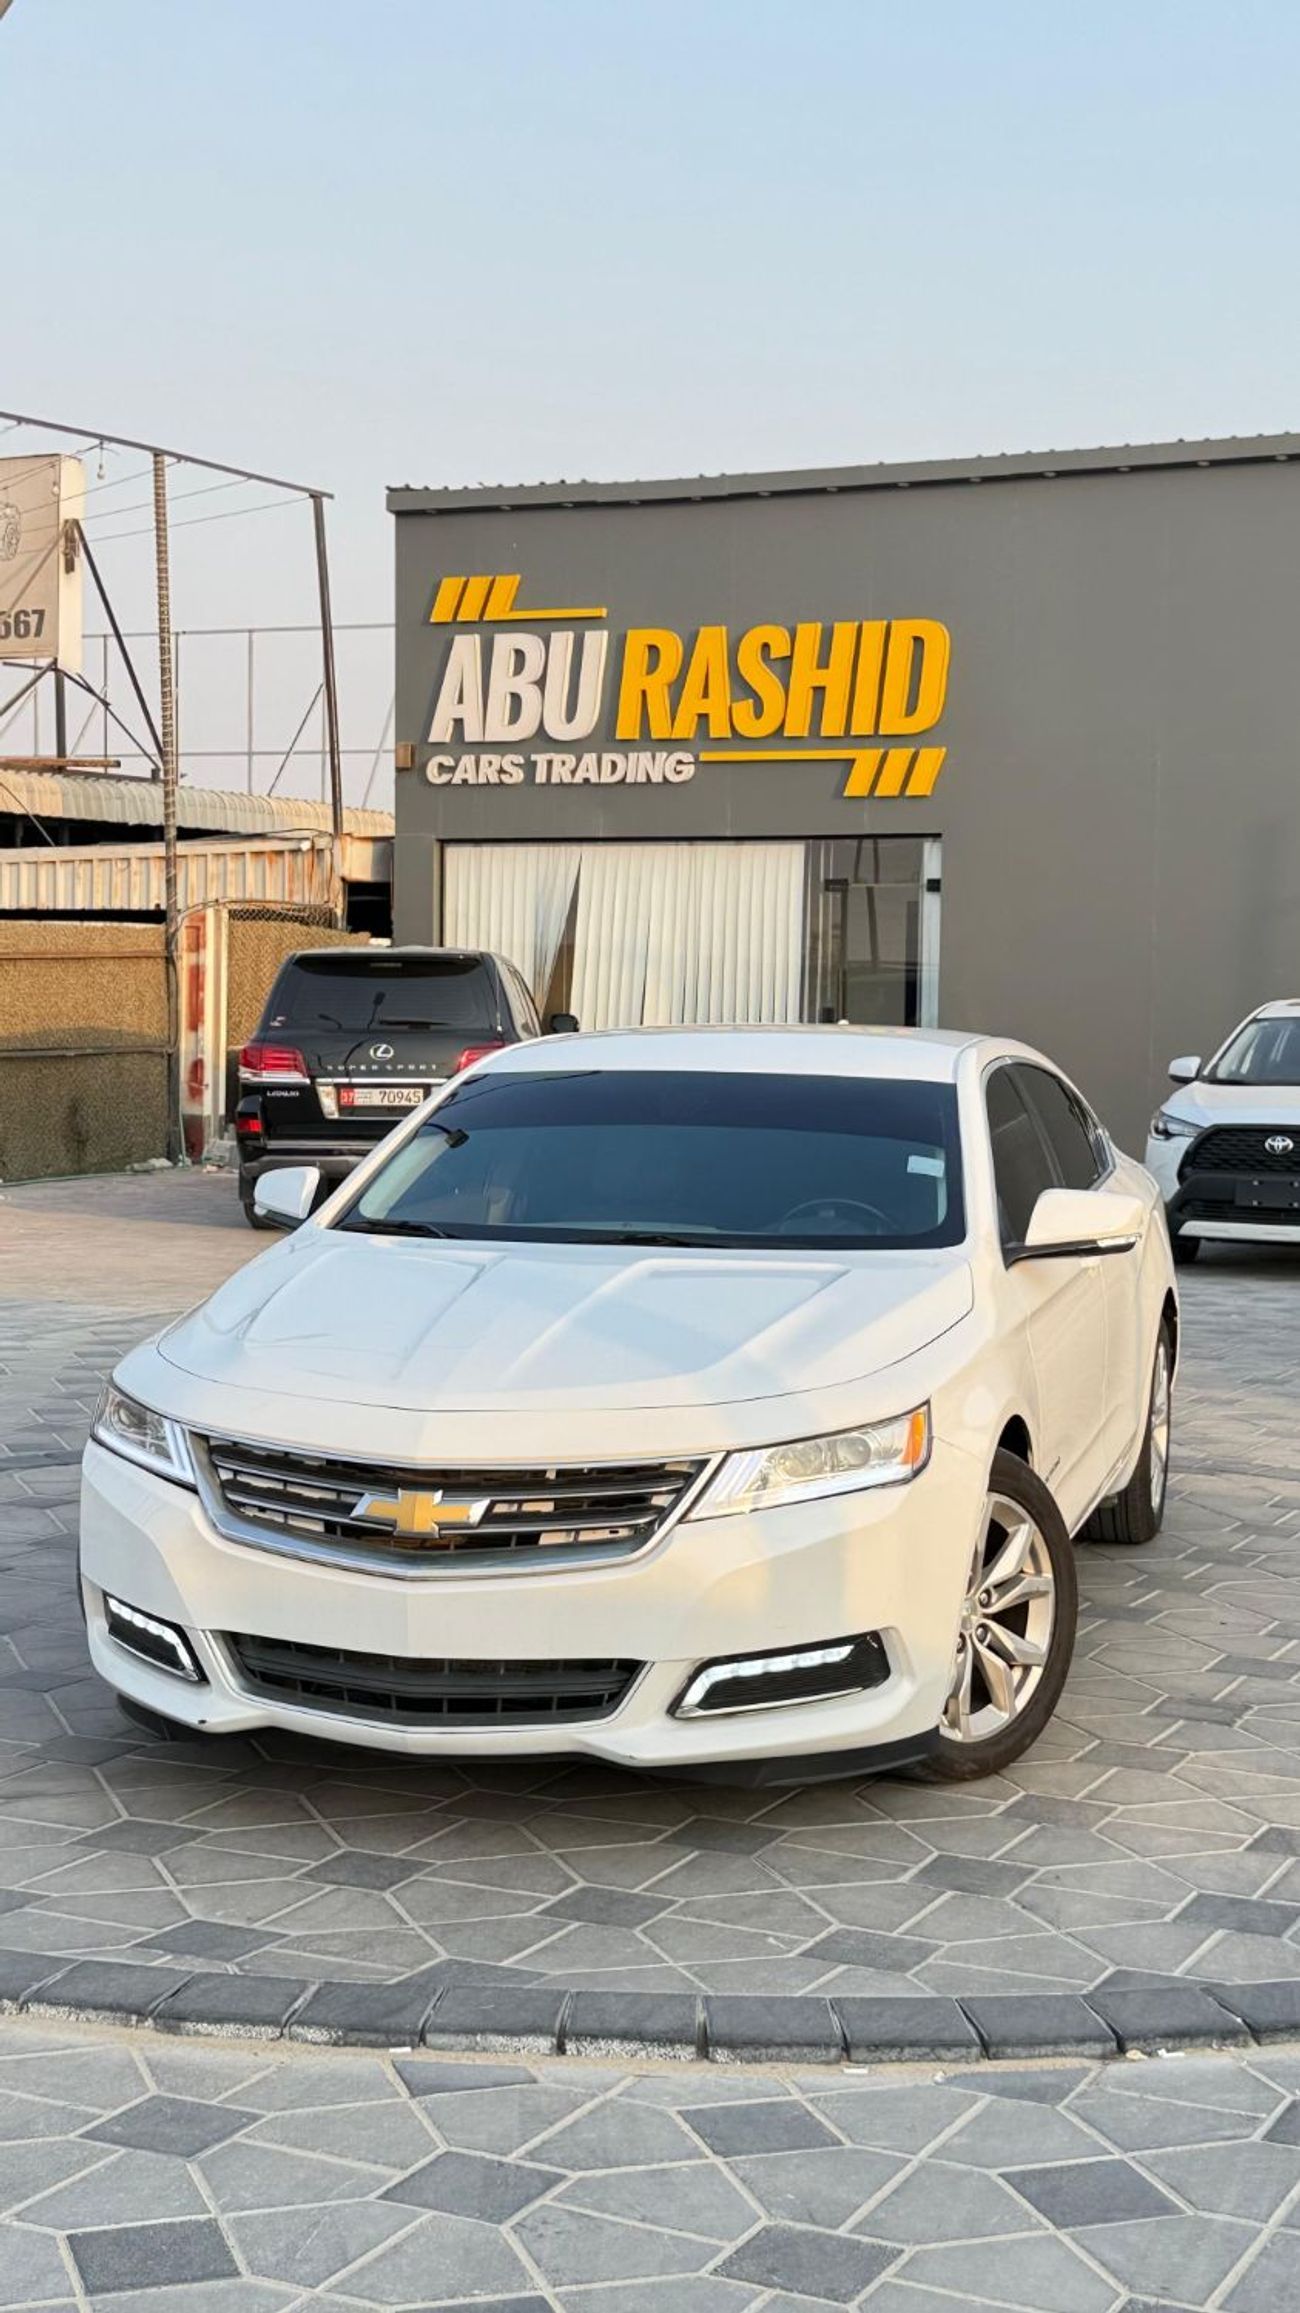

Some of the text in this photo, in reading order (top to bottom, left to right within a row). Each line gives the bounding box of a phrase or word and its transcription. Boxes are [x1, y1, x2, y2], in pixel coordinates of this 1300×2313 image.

[428, 619, 950, 743] ABU RASHID
[425, 751, 696, 785] CARS TRADING
[379, 1090, 421, 1104] 70945
